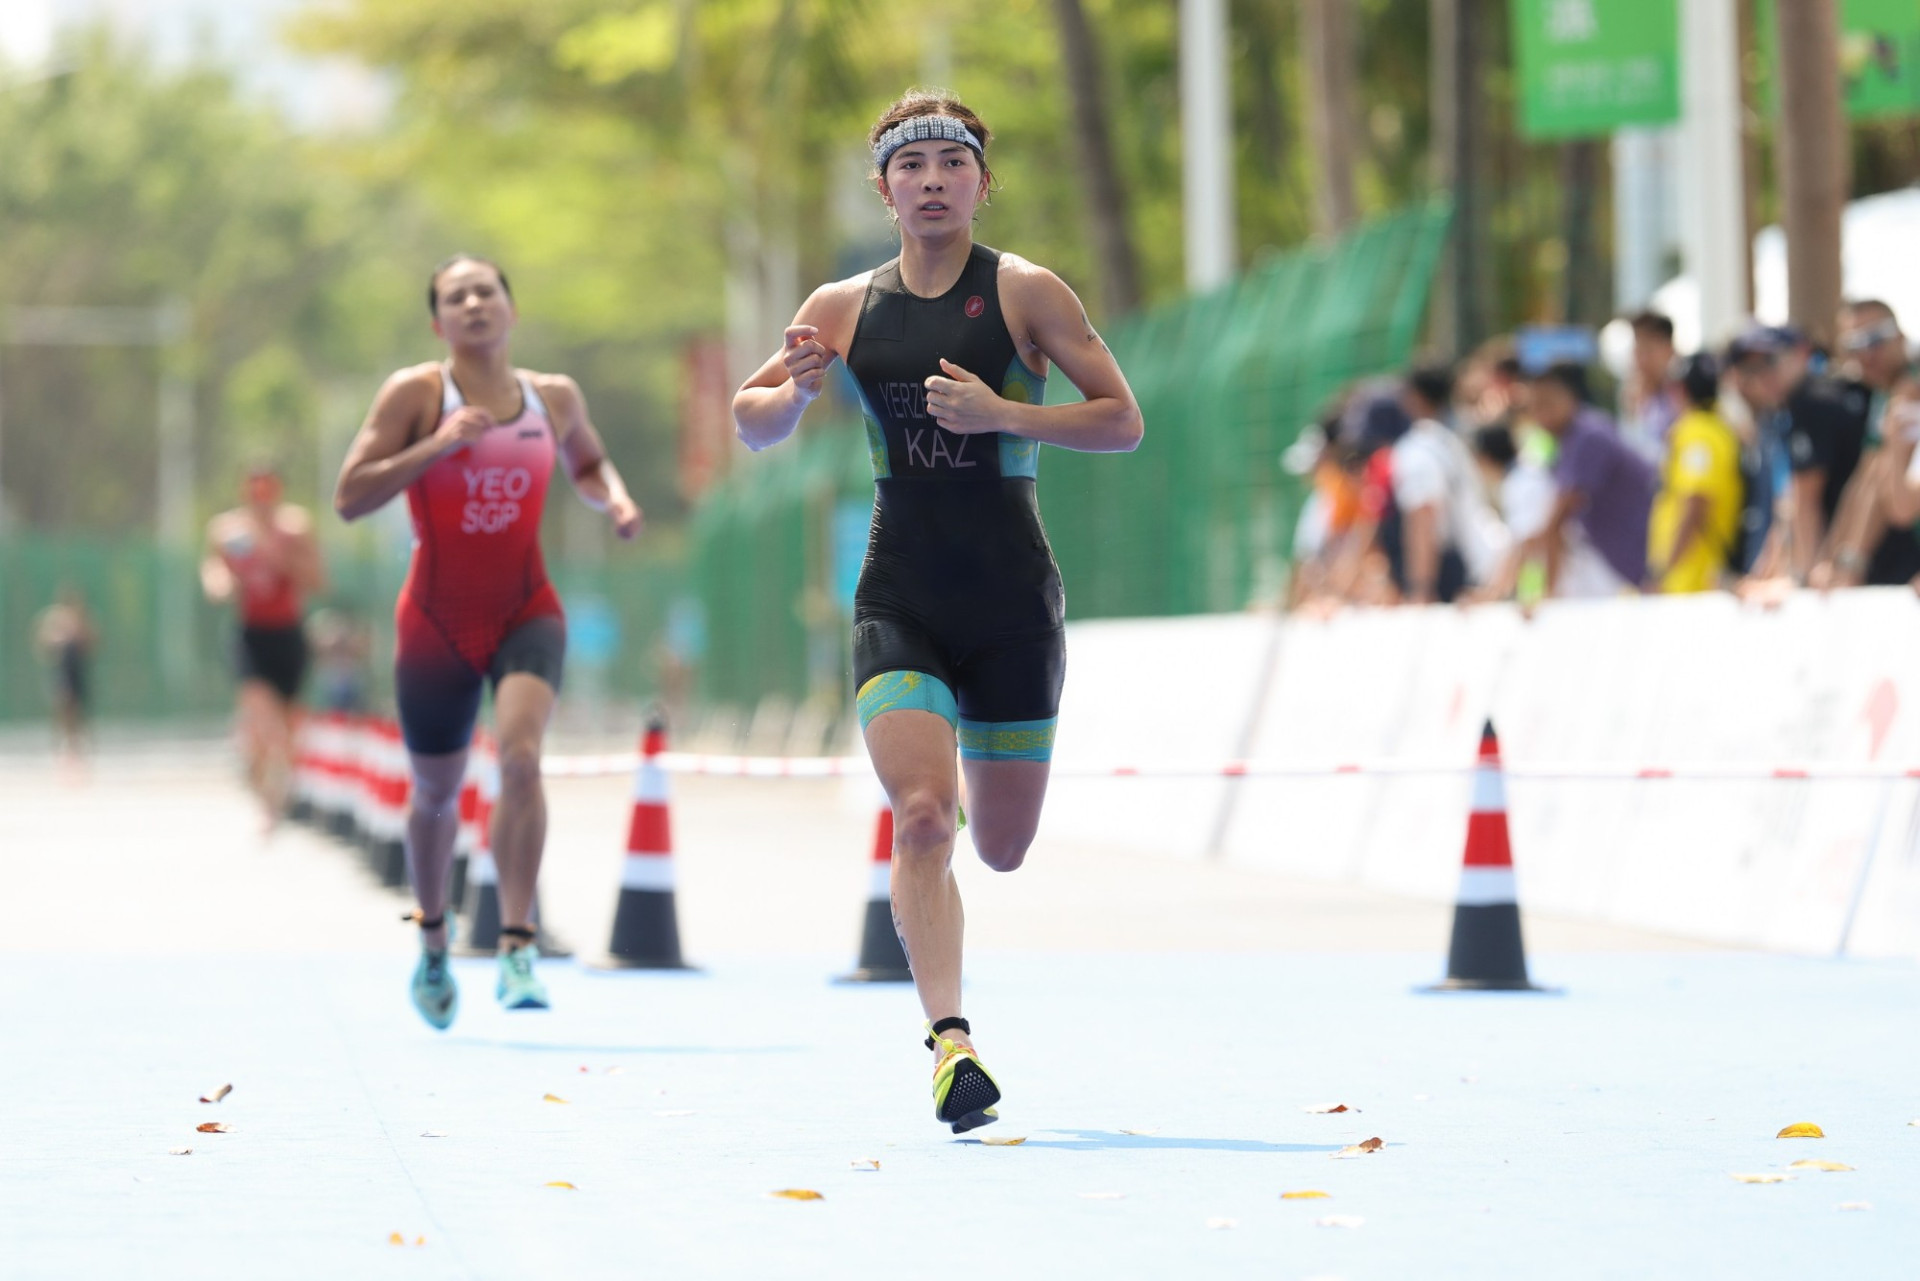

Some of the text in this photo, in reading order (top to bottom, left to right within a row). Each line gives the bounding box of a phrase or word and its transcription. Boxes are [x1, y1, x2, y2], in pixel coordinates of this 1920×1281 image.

[878, 382, 937, 419] YERZH
[904, 428, 977, 469] KAZ
[461, 466, 532, 501] YEO
[460, 501, 521, 535] SGP
